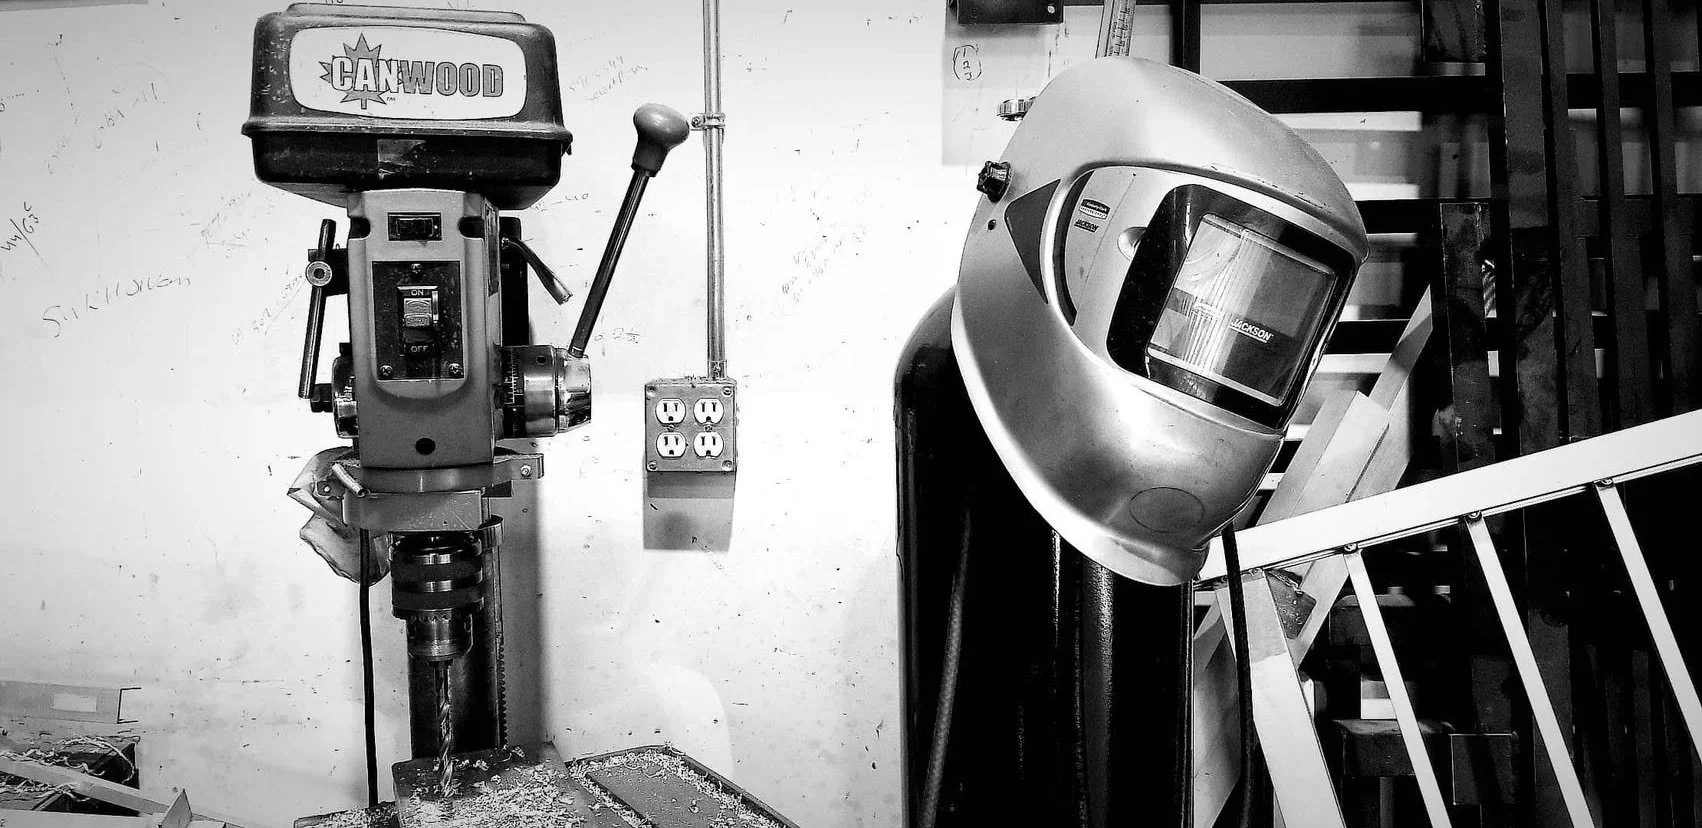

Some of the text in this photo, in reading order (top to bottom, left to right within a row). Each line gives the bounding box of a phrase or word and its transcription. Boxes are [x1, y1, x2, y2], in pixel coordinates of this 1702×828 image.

[331, 55, 504, 97] CANWOOD
[1230, 319, 1272, 341] JACKSON
[411, 345, 428, 353] OFF
